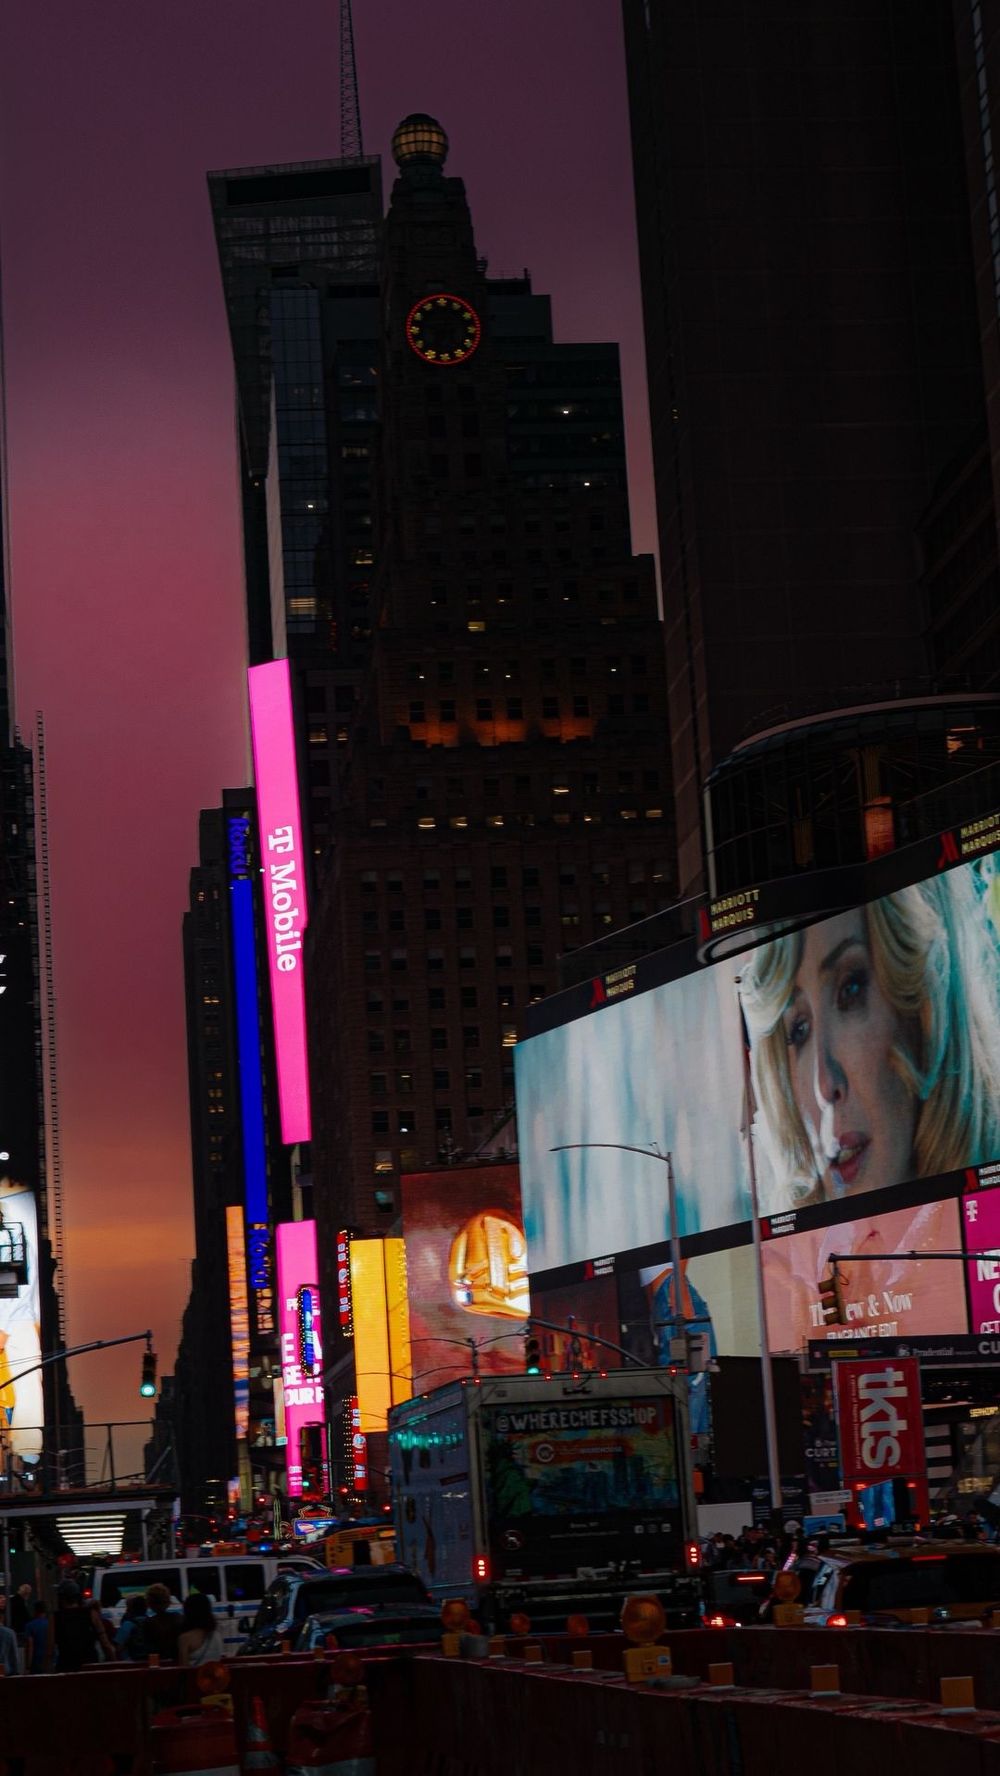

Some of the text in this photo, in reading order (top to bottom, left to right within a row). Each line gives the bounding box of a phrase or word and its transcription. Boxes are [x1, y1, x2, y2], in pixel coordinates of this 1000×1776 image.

[711, 889, 760, 915] MARRIOTT
[270, 860, 301, 972] Mobile
[712, 908, 754, 931] MARQUIS
[882, 1290, 913, 1314] Now
[496, 1407, 657, 1432] @WHERECHEFSSHOP
[858, 1367, 908, 1469] tkts
